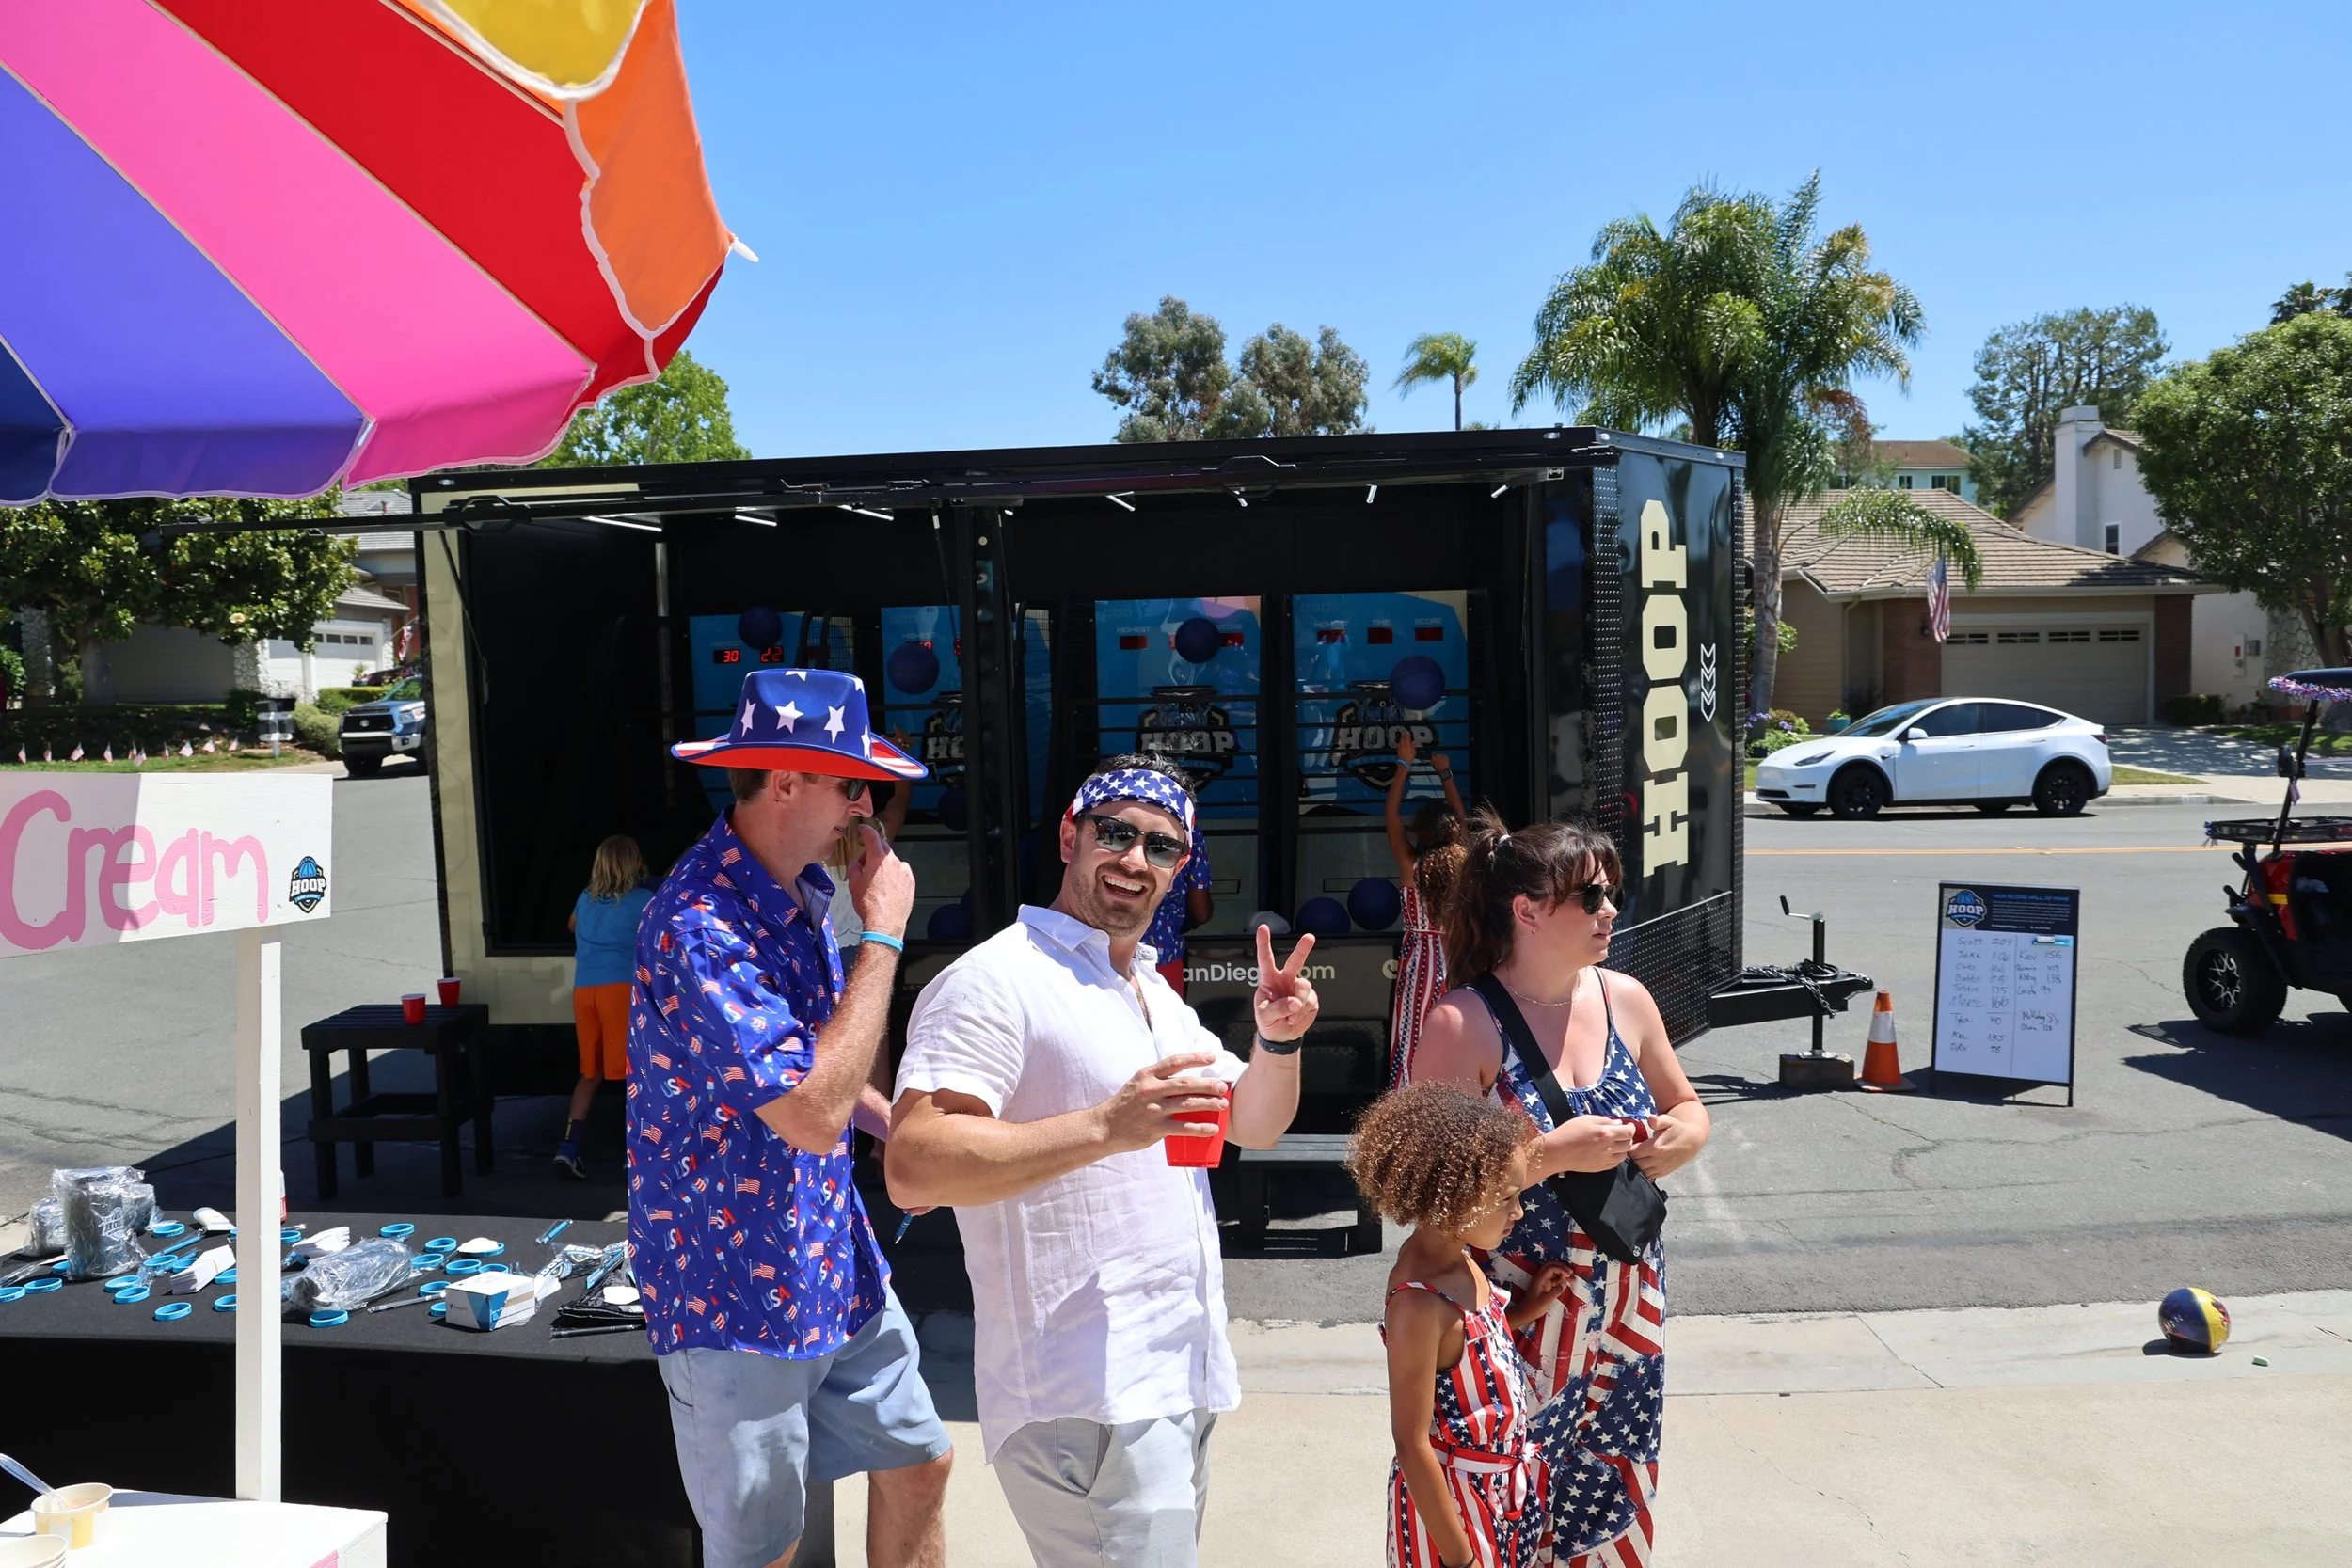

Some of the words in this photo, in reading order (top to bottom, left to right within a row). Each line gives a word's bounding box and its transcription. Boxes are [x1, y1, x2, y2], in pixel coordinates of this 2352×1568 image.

[723, 649, 739, 663] 30
[1640, 499, 1689, 878] HOOP
[0, 789, 269, 950] Cream
[290, 878, 326, 897] HOOP
[1947, 904, 1985, 916] HOOP
[660, 1076, 692, 1098] USA
[673, 1153, 698, 1180] USA
[818, 1178, 836, 1207] USA
[716, 1206, 737, 1231] SA
[663, 1227, 685, 1252] USA
[760, 1285, 793, 1312] USA
